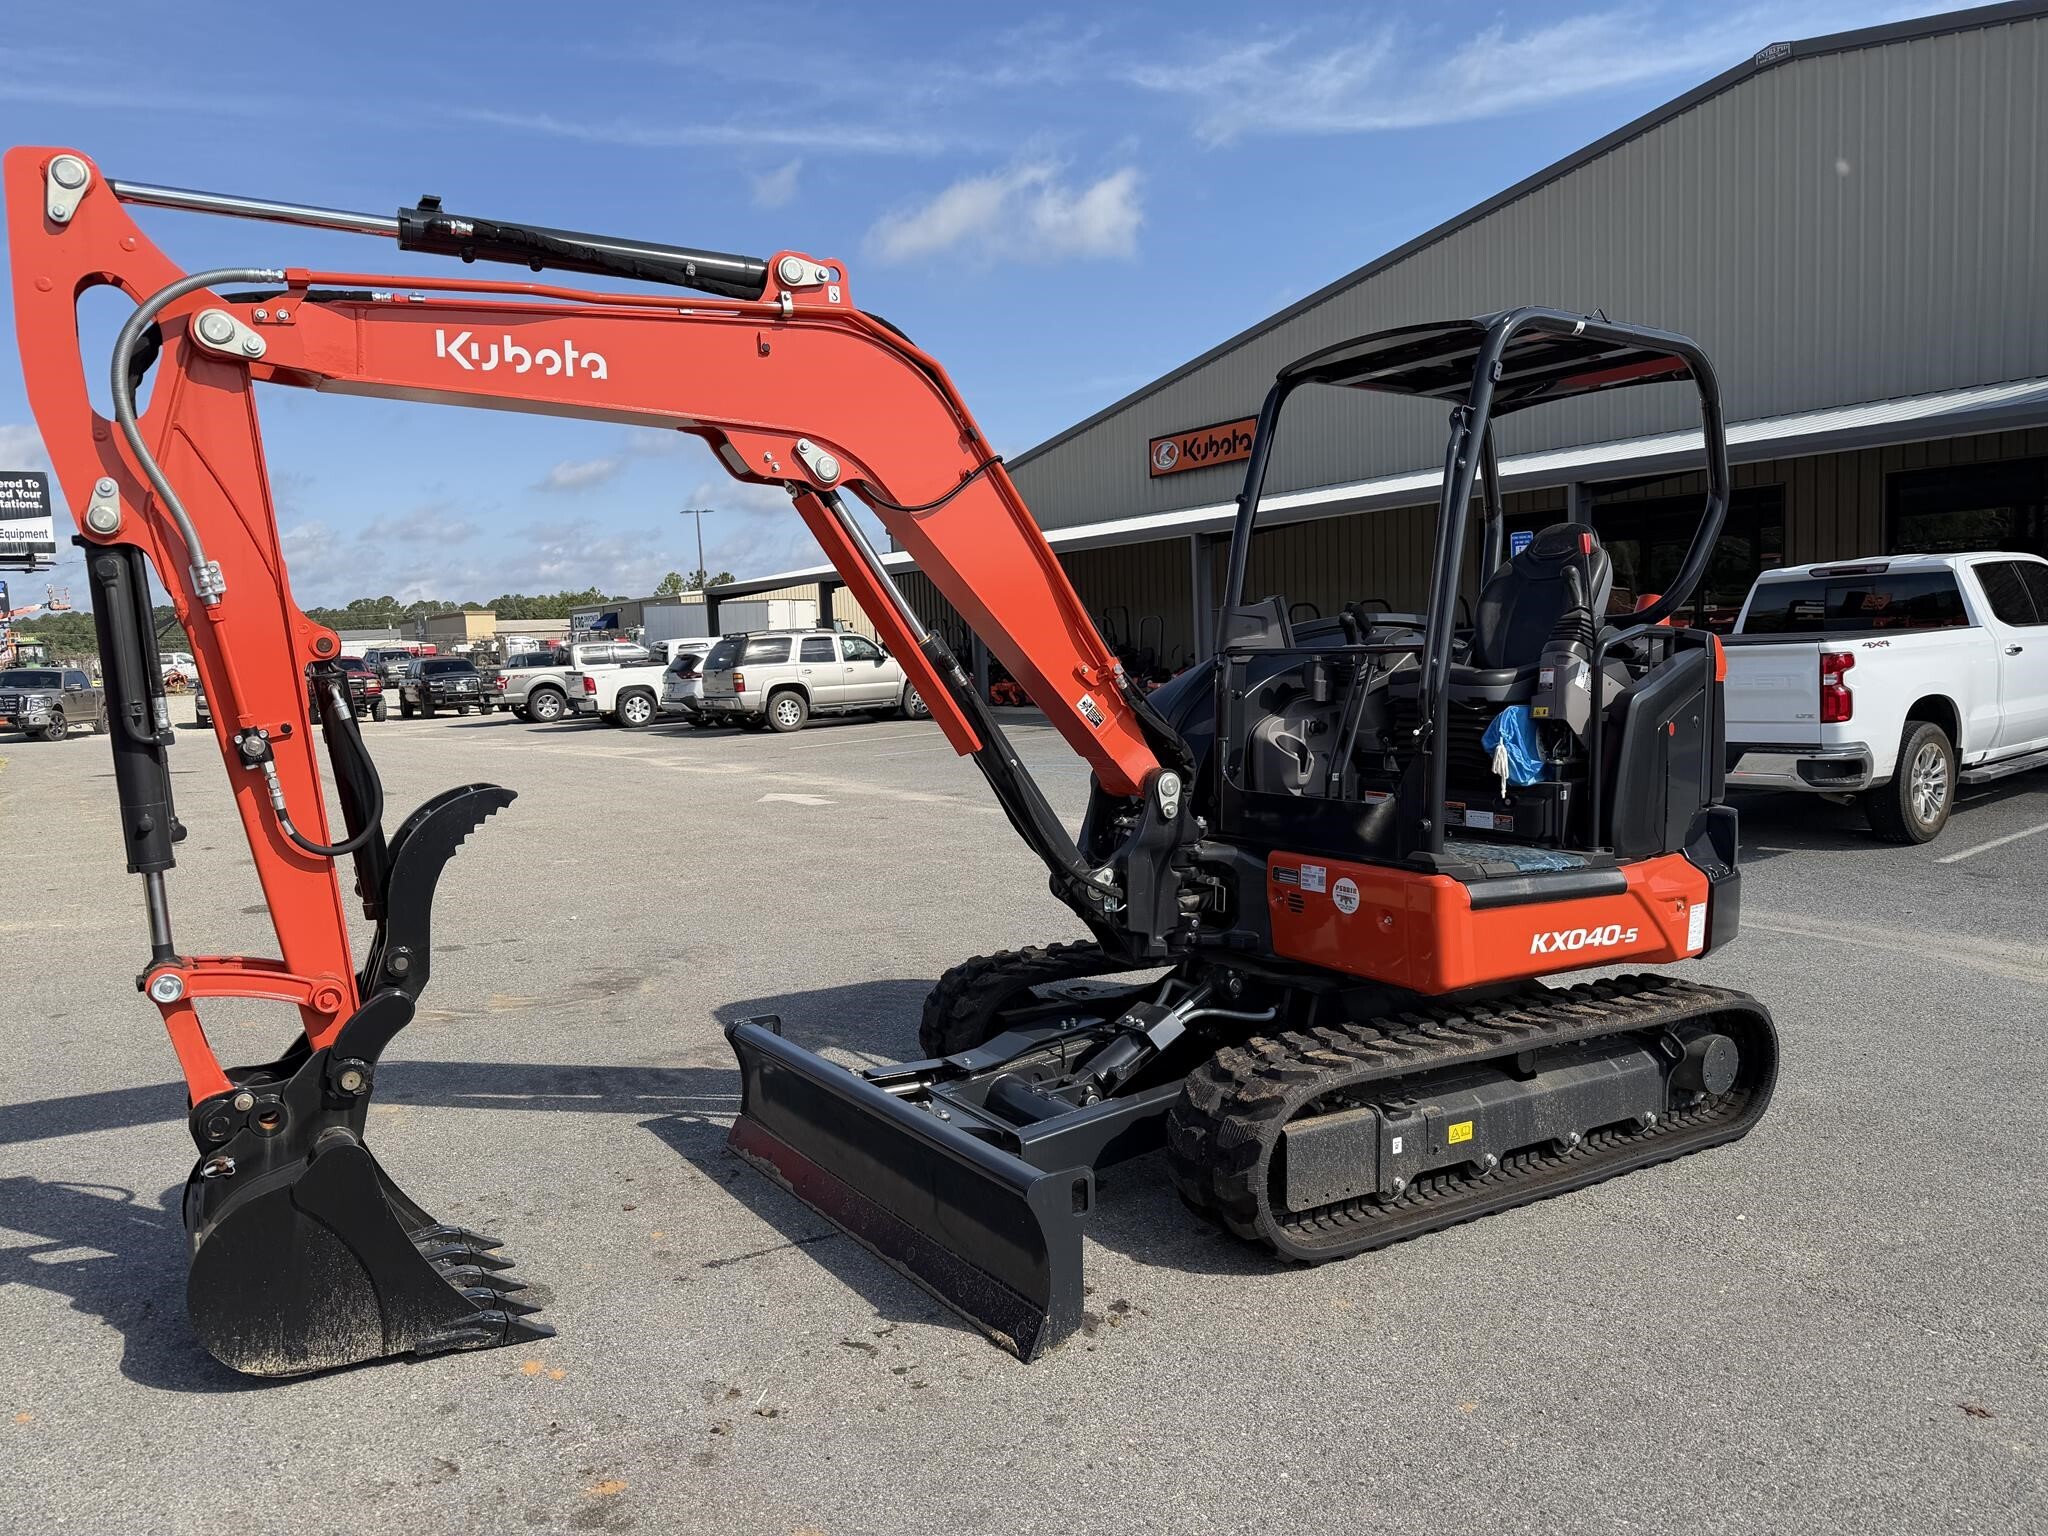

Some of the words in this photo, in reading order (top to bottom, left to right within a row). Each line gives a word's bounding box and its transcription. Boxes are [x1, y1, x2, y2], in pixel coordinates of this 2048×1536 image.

[435, 329, 608, 379] Kubota
[1183, 429, 1252, 461] Kubota
[25, 479, 39, 488] To
[16, 490, 41, 499] Your
[0, 528, 48, 540] Equipment
[1530, 924, 1639, 954] KX040-5
